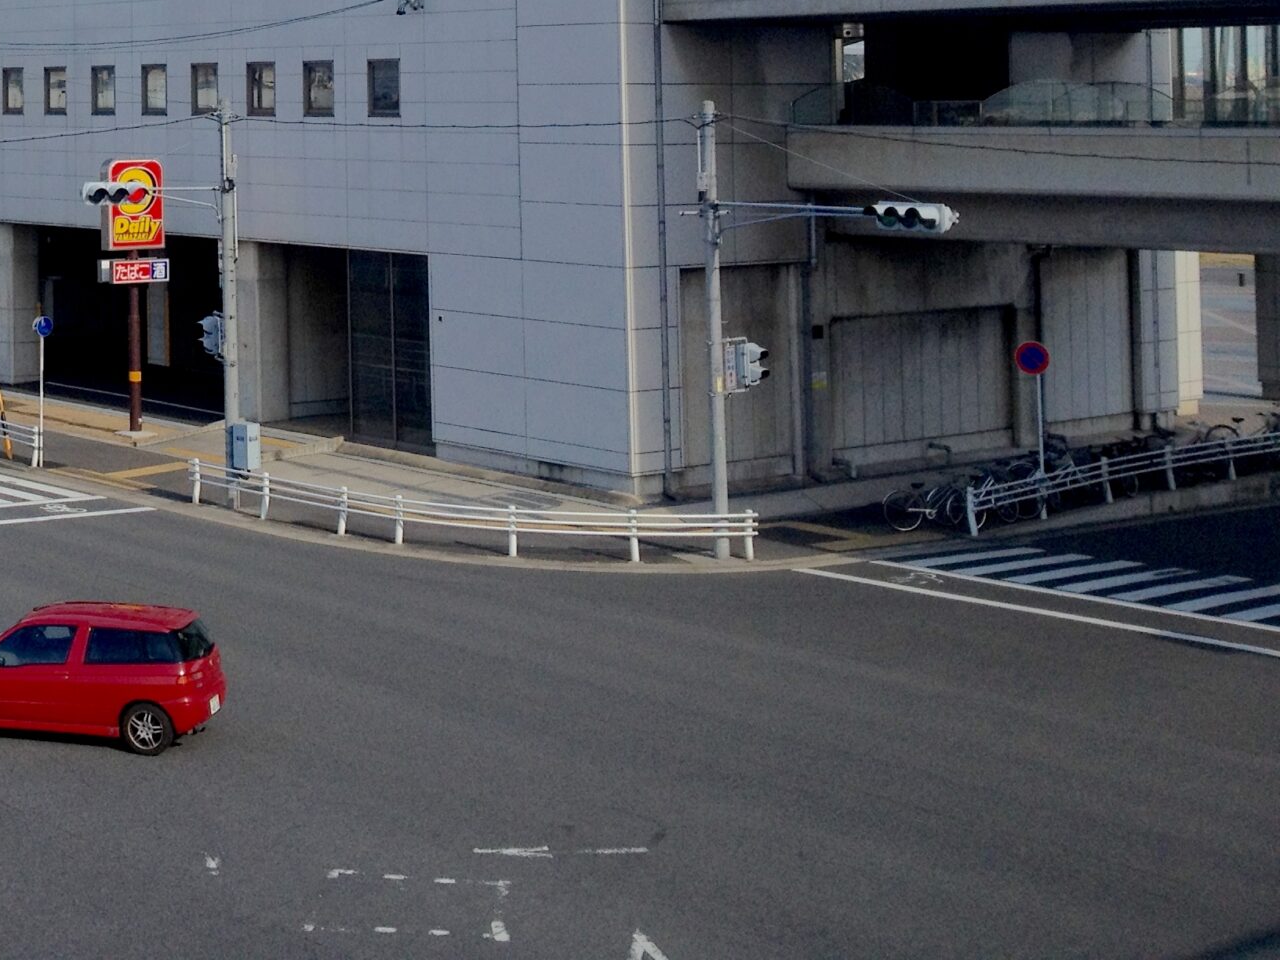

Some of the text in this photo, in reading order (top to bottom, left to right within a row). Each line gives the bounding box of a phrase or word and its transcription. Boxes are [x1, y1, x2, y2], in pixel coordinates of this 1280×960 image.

[115, 216, 160, 240] Daily
[116, 262, 166, 279] たばこ 酒
